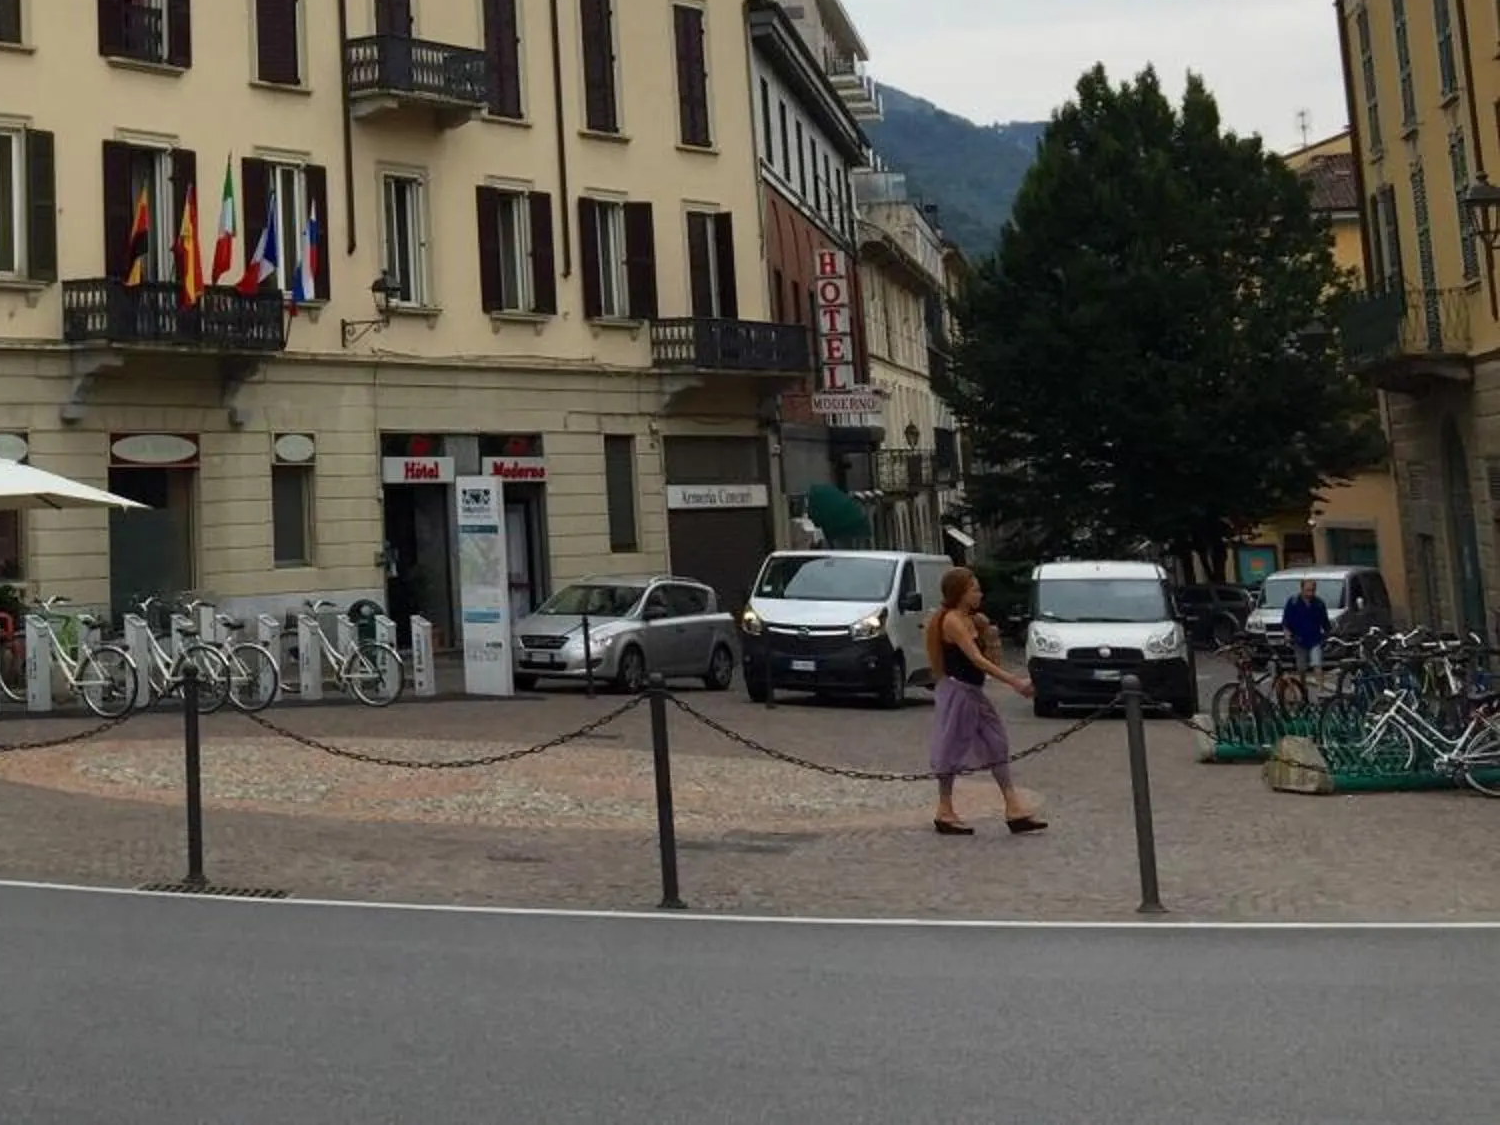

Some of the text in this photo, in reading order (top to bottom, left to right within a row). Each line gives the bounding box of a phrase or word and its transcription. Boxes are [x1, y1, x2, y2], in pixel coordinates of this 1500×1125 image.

[818, 251, 847, 391] HOTEL
[813, 396, 877, 411] MODERNO
[491, 460, 546, 479] Moderno
